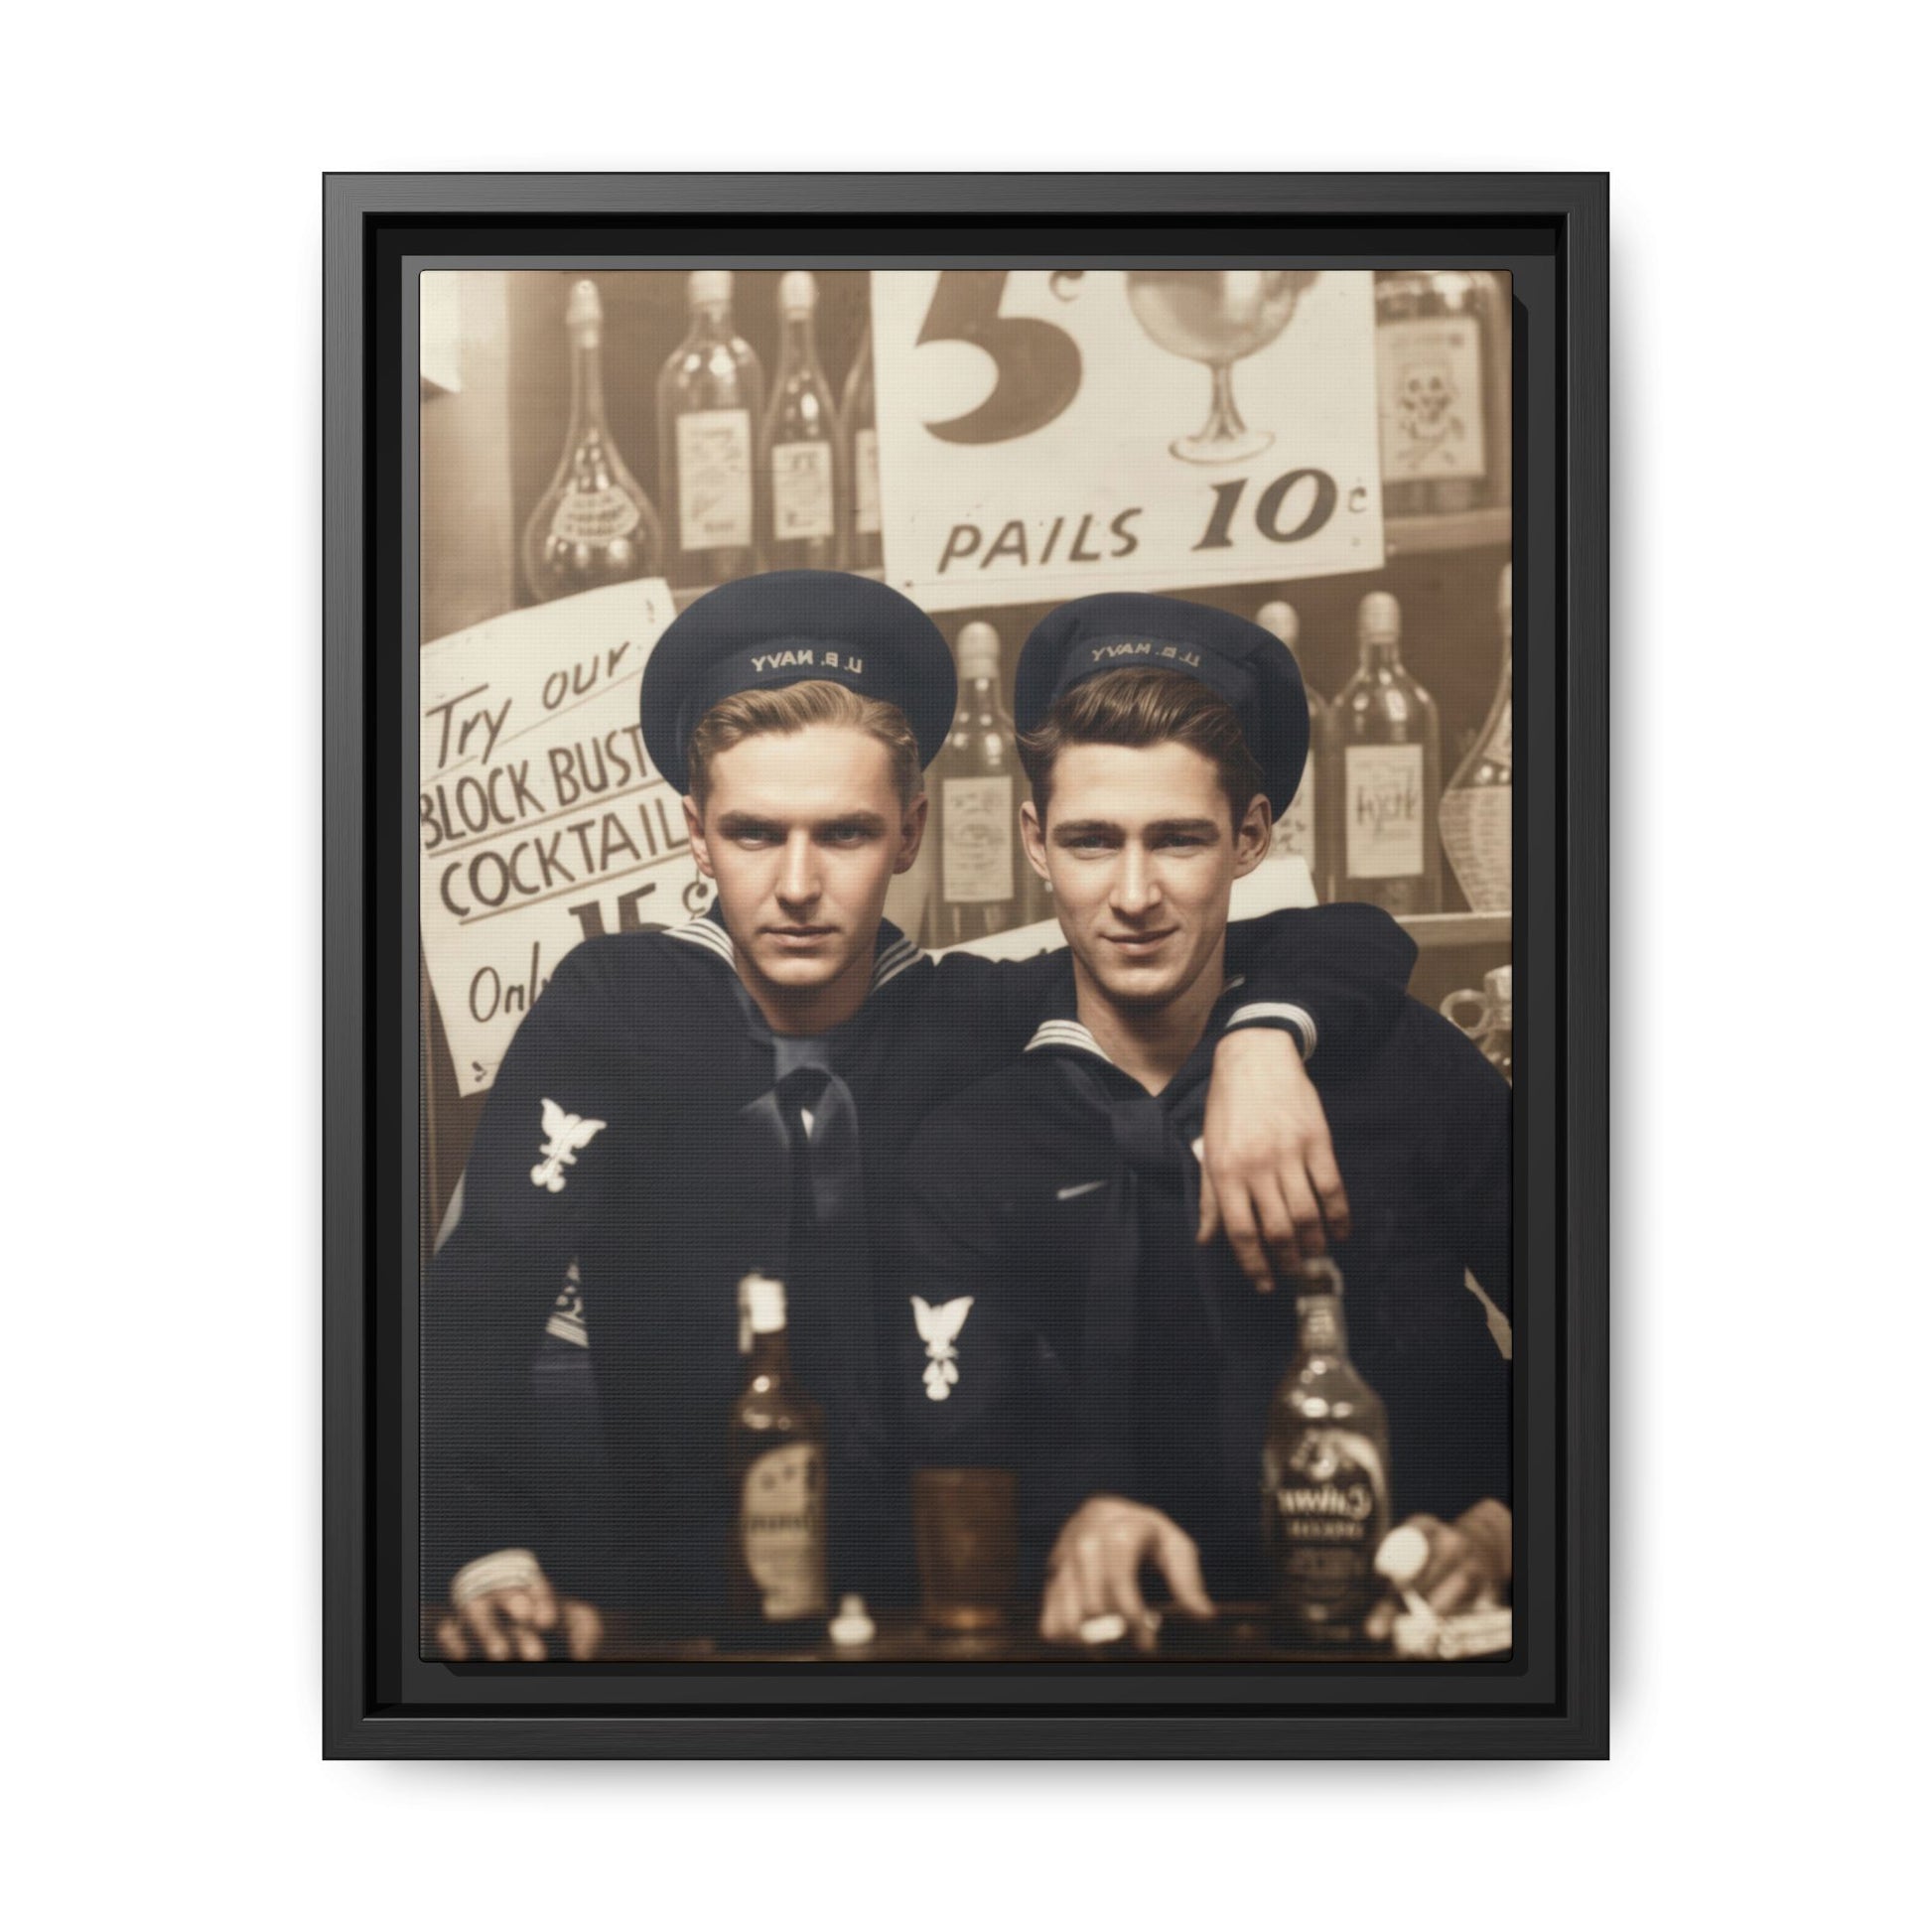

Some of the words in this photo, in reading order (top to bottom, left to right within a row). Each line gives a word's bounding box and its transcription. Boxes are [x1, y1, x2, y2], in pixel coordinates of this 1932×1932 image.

[937, 507, 1143, 574] PAILS
[425, 683, 512, 769] Try
[541, 640, 630, 711] our
[420, 759, 546, 851] BLOCK
[440, 797, 691, 917] COCKTAIL
[469, 941, 550, 1024] Onl
